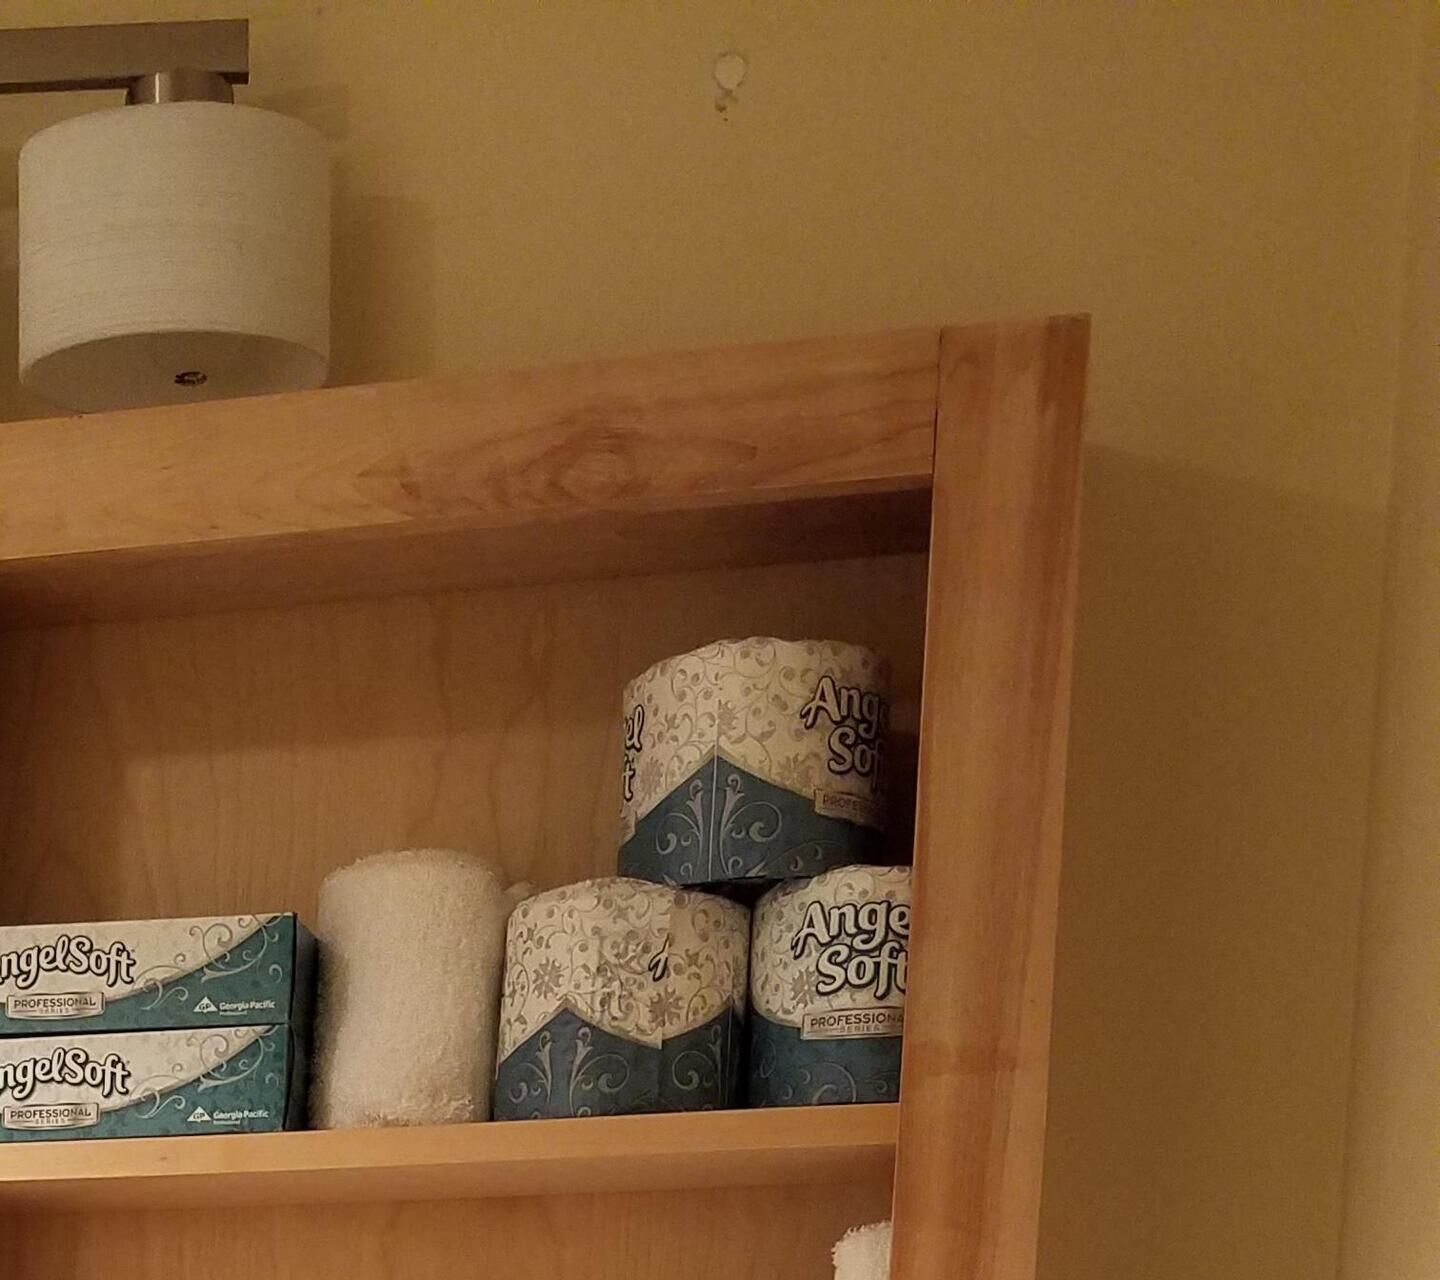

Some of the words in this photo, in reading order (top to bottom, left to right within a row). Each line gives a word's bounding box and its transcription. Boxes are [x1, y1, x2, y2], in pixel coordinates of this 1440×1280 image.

[791, 900, 911, 960] Ange
[14, 997, 97, 1009] PROFESSIONAL
[810, 1012, 903, 1027] PROFESSIONA
[10, 1107, 92, 1120] PROFESSIONAL
